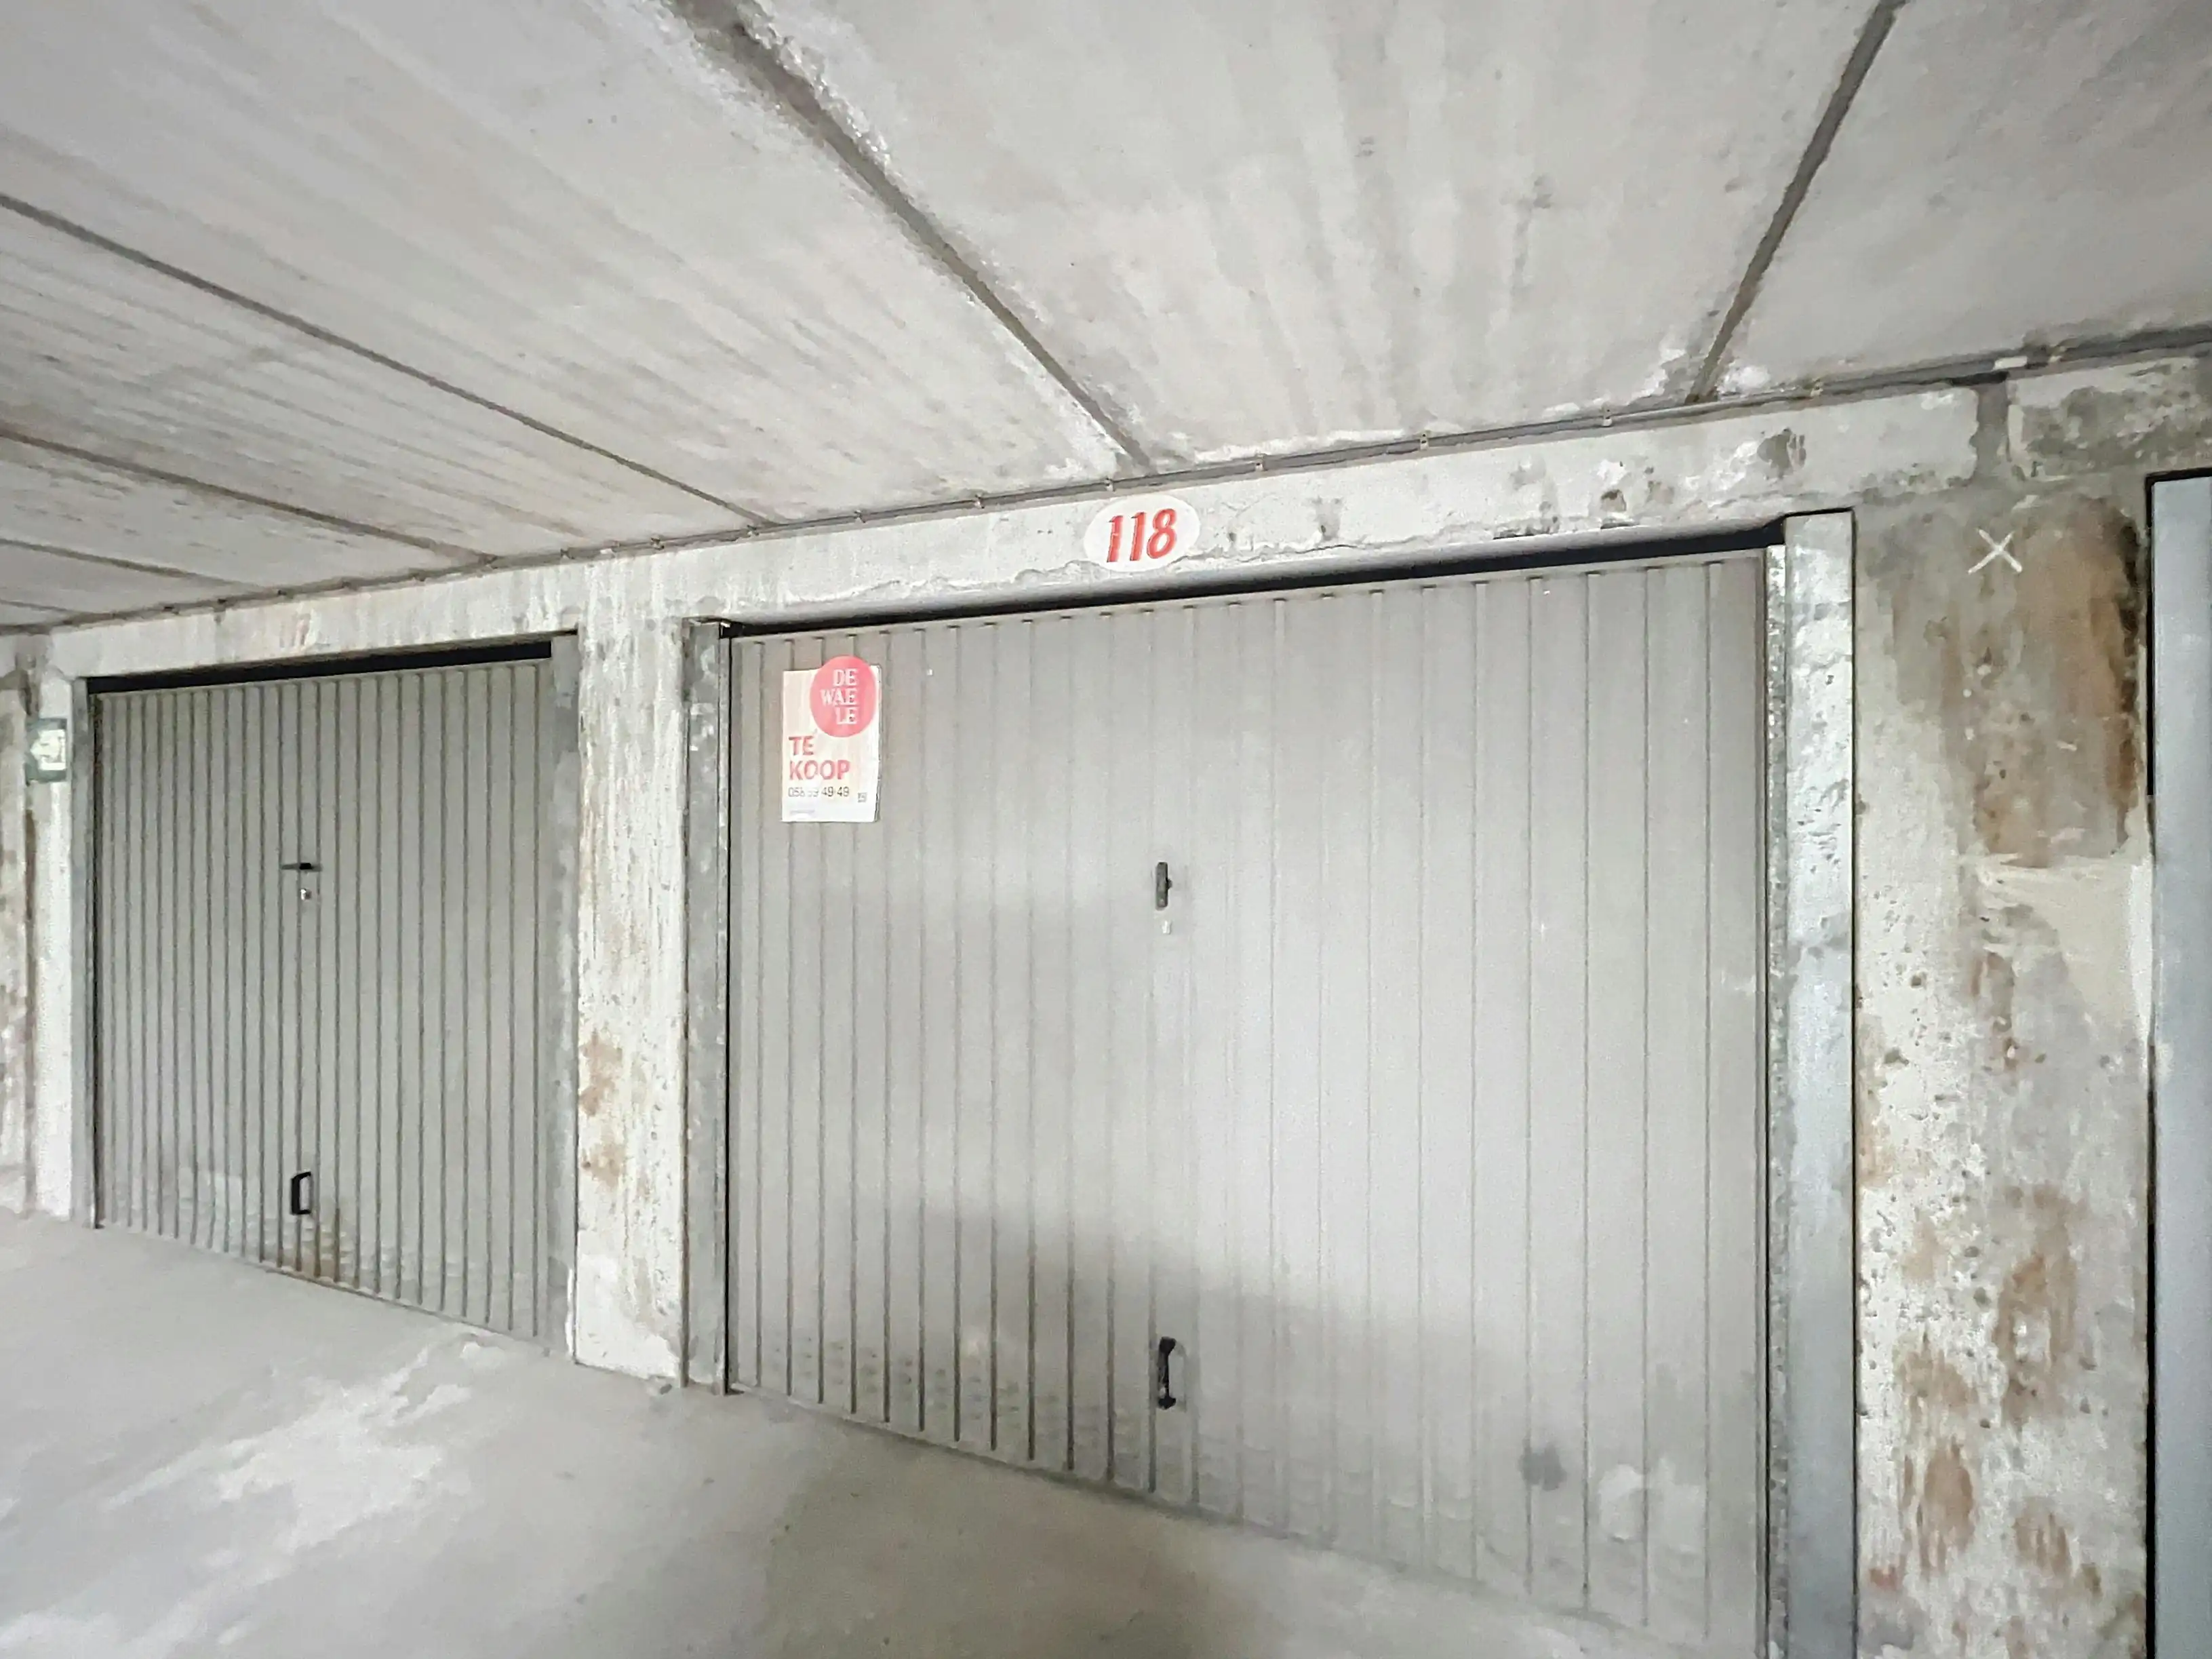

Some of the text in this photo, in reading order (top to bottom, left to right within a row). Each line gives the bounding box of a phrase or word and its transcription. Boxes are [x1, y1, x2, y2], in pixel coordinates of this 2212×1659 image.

[1107, 509, 1177, 562] 118
[833, 668, 858, 686] DE
[820, 688, 858, 706] WAE
[835, 707, 859, 724] LE
[788, 736, 815, 756] TE
[789, 760, 851, 781] KOOP
